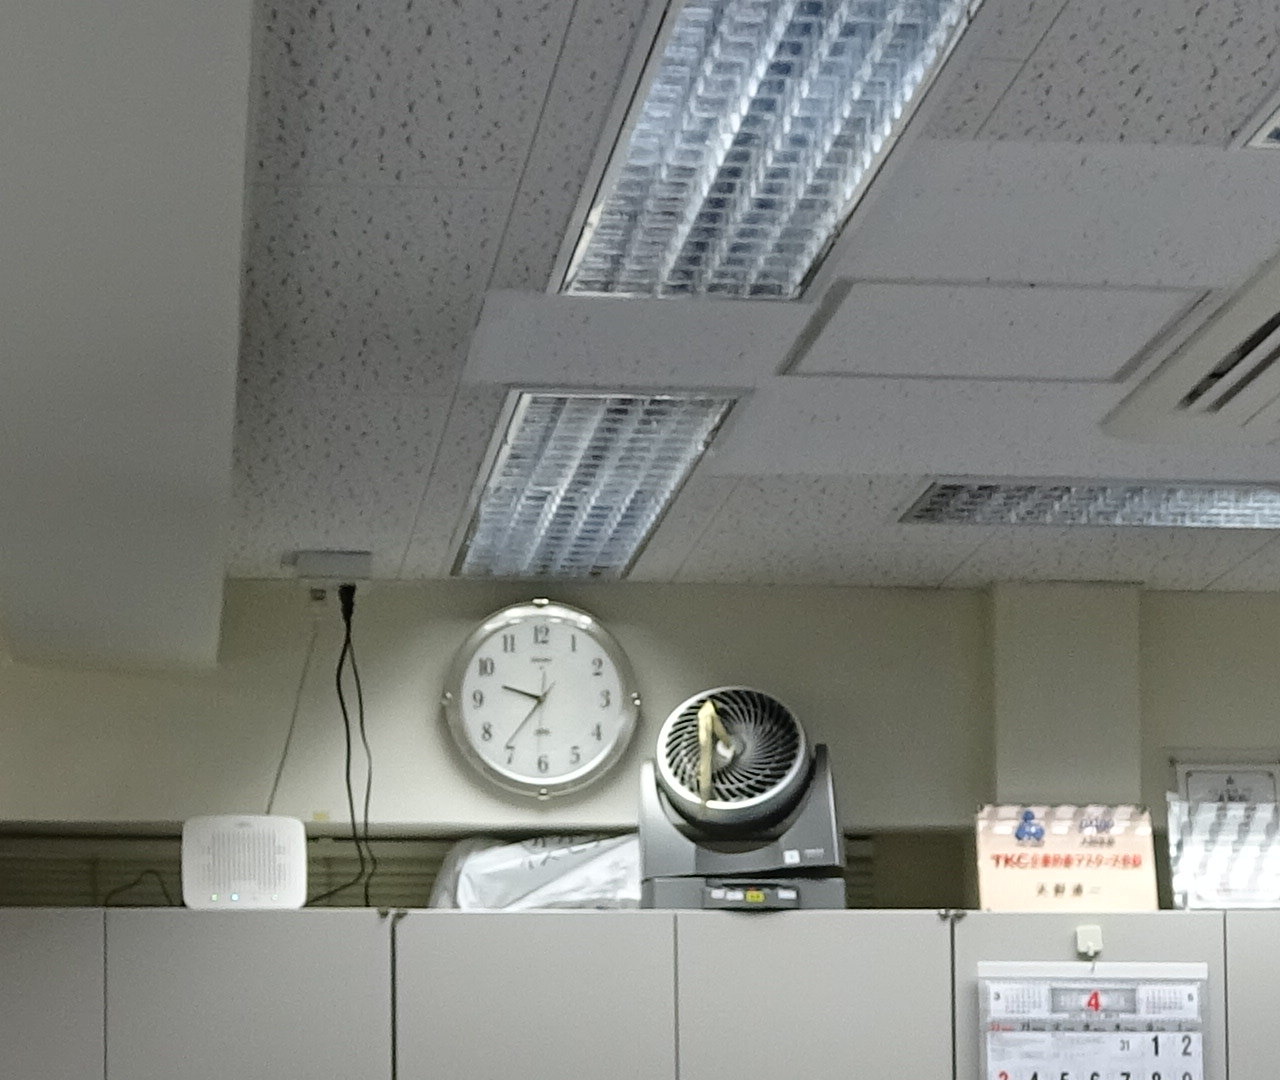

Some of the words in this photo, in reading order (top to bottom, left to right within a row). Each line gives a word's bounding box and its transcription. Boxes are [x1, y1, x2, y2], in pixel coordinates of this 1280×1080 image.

[503, 634, 515, 653] 11
[534, 626, 550, 644] 12
[571, 635, 576, 652] 1
[479, 658, 494, 676] 10
[593, 658, 603, 676] 2
[473, 690, 483, 707] 9
[602, 690, 610, 708] 3
[482, 724, 492, 741] 8
[592, 724, 601, 741] 4
[505, 745, 515, 764] 7
[571, 746, 580, 764] 5
[538, 757, 548, 772] 6
[1086, 990, 1100, 1012] 4
[1120, 1040, 1129, 1051] 31
[1152, 1036, 1158, 1056] 1
[1182, 1035, 1191, 1056] 2
